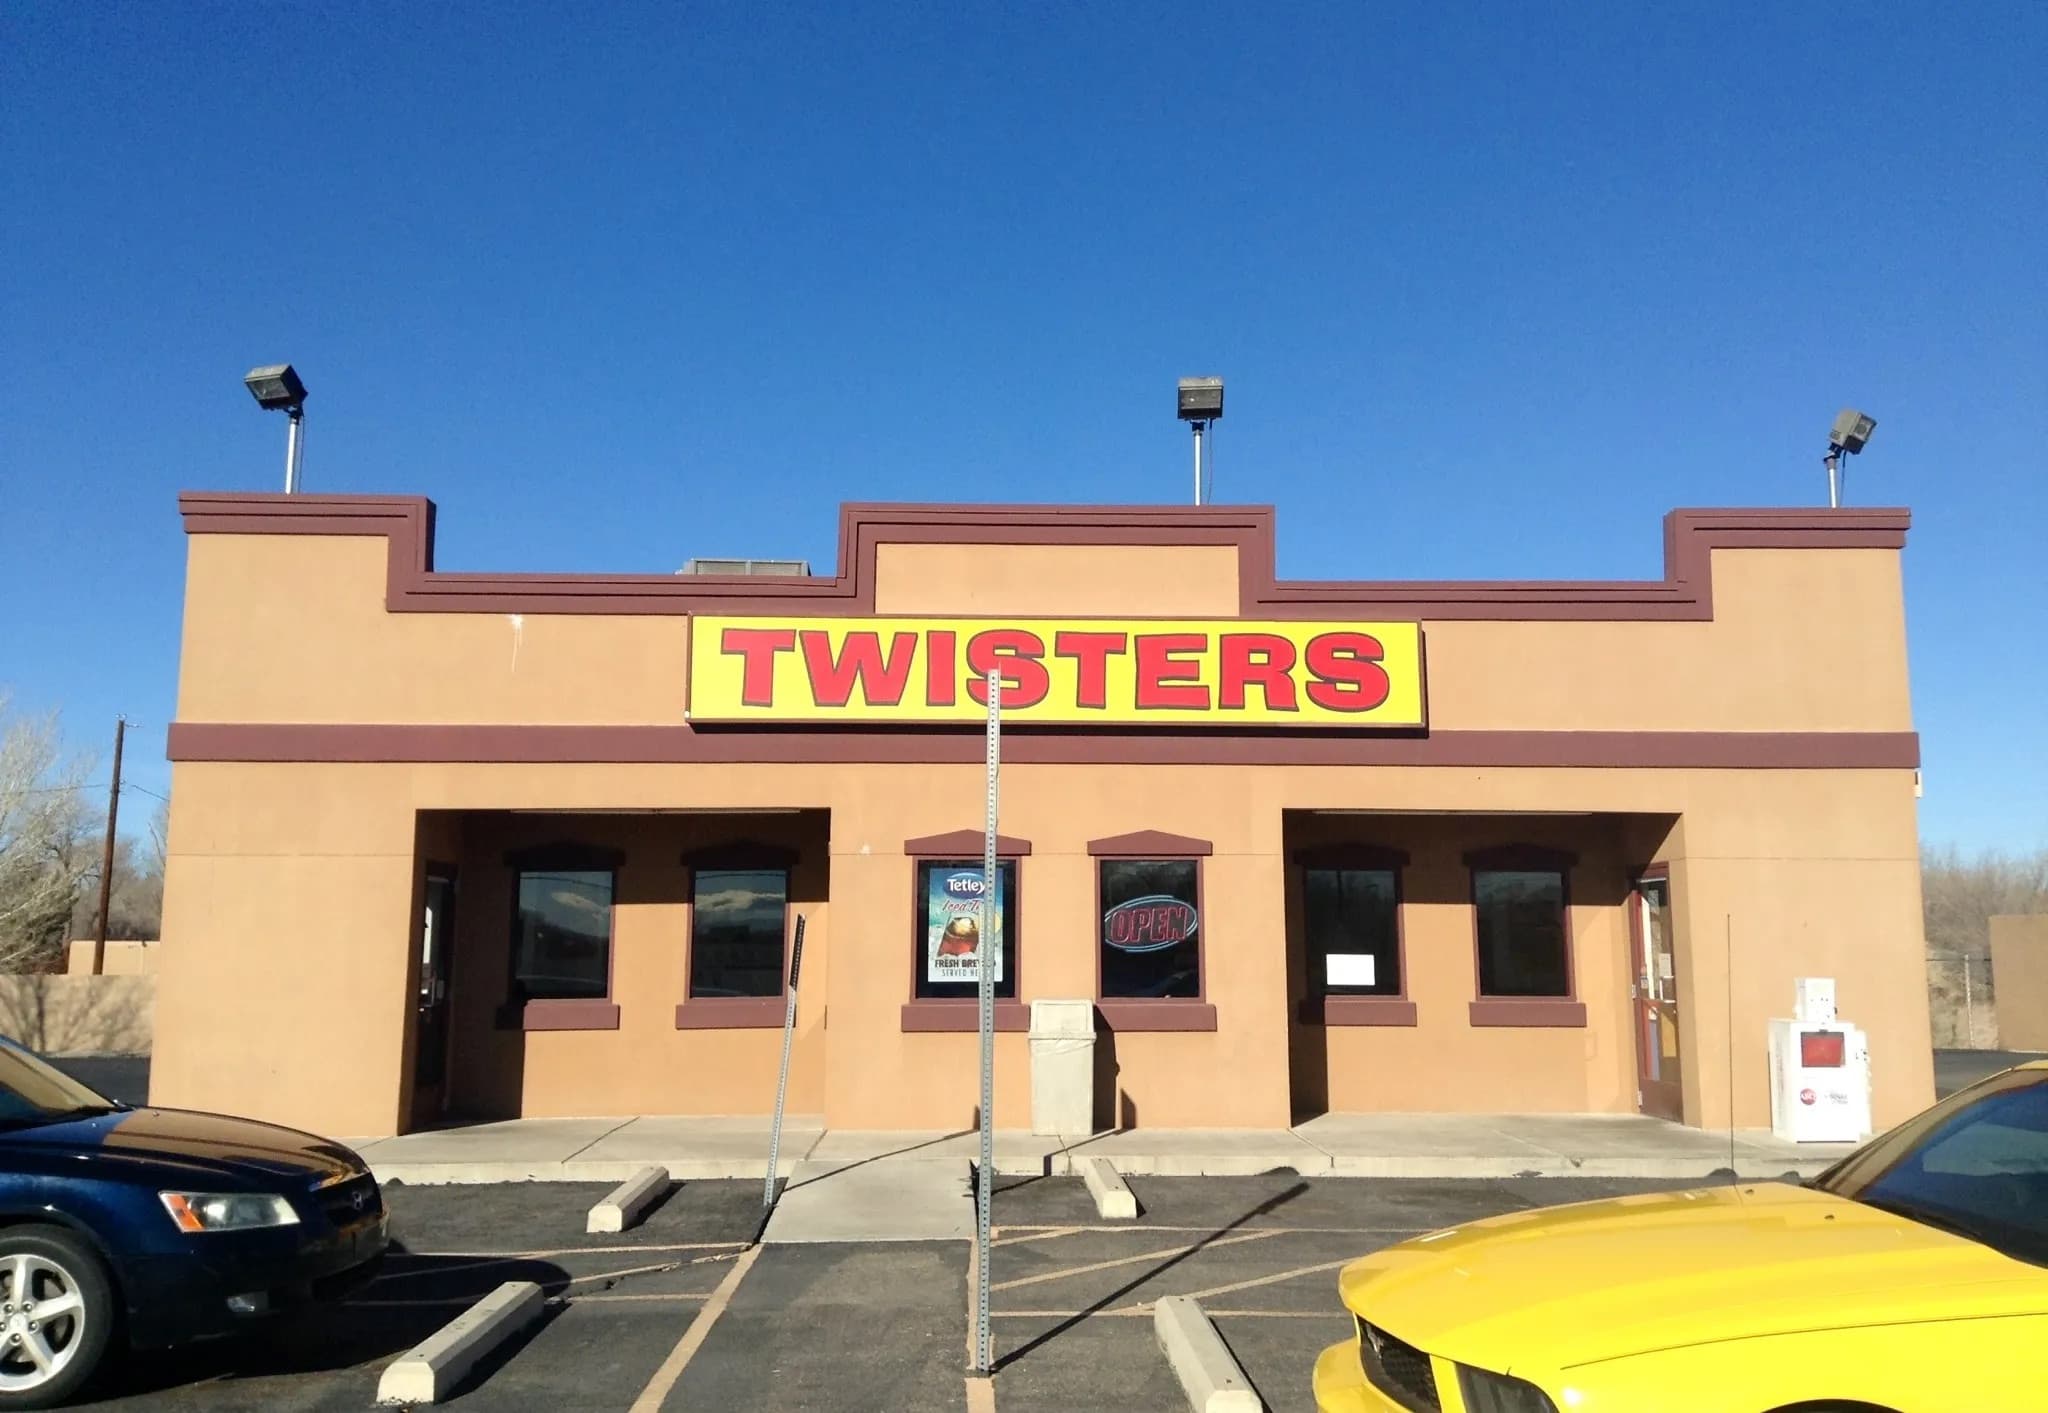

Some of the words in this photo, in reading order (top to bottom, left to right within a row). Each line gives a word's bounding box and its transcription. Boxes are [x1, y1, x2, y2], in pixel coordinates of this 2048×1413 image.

[720, 628, 1390, 713] TWISTERS
[946, 879, 985, 895] Tetley
[1110, 906, 1188, 943] OPEN
[935, 959, 959, 968] FRESH
[942, 968, 966, 977] SERVED
